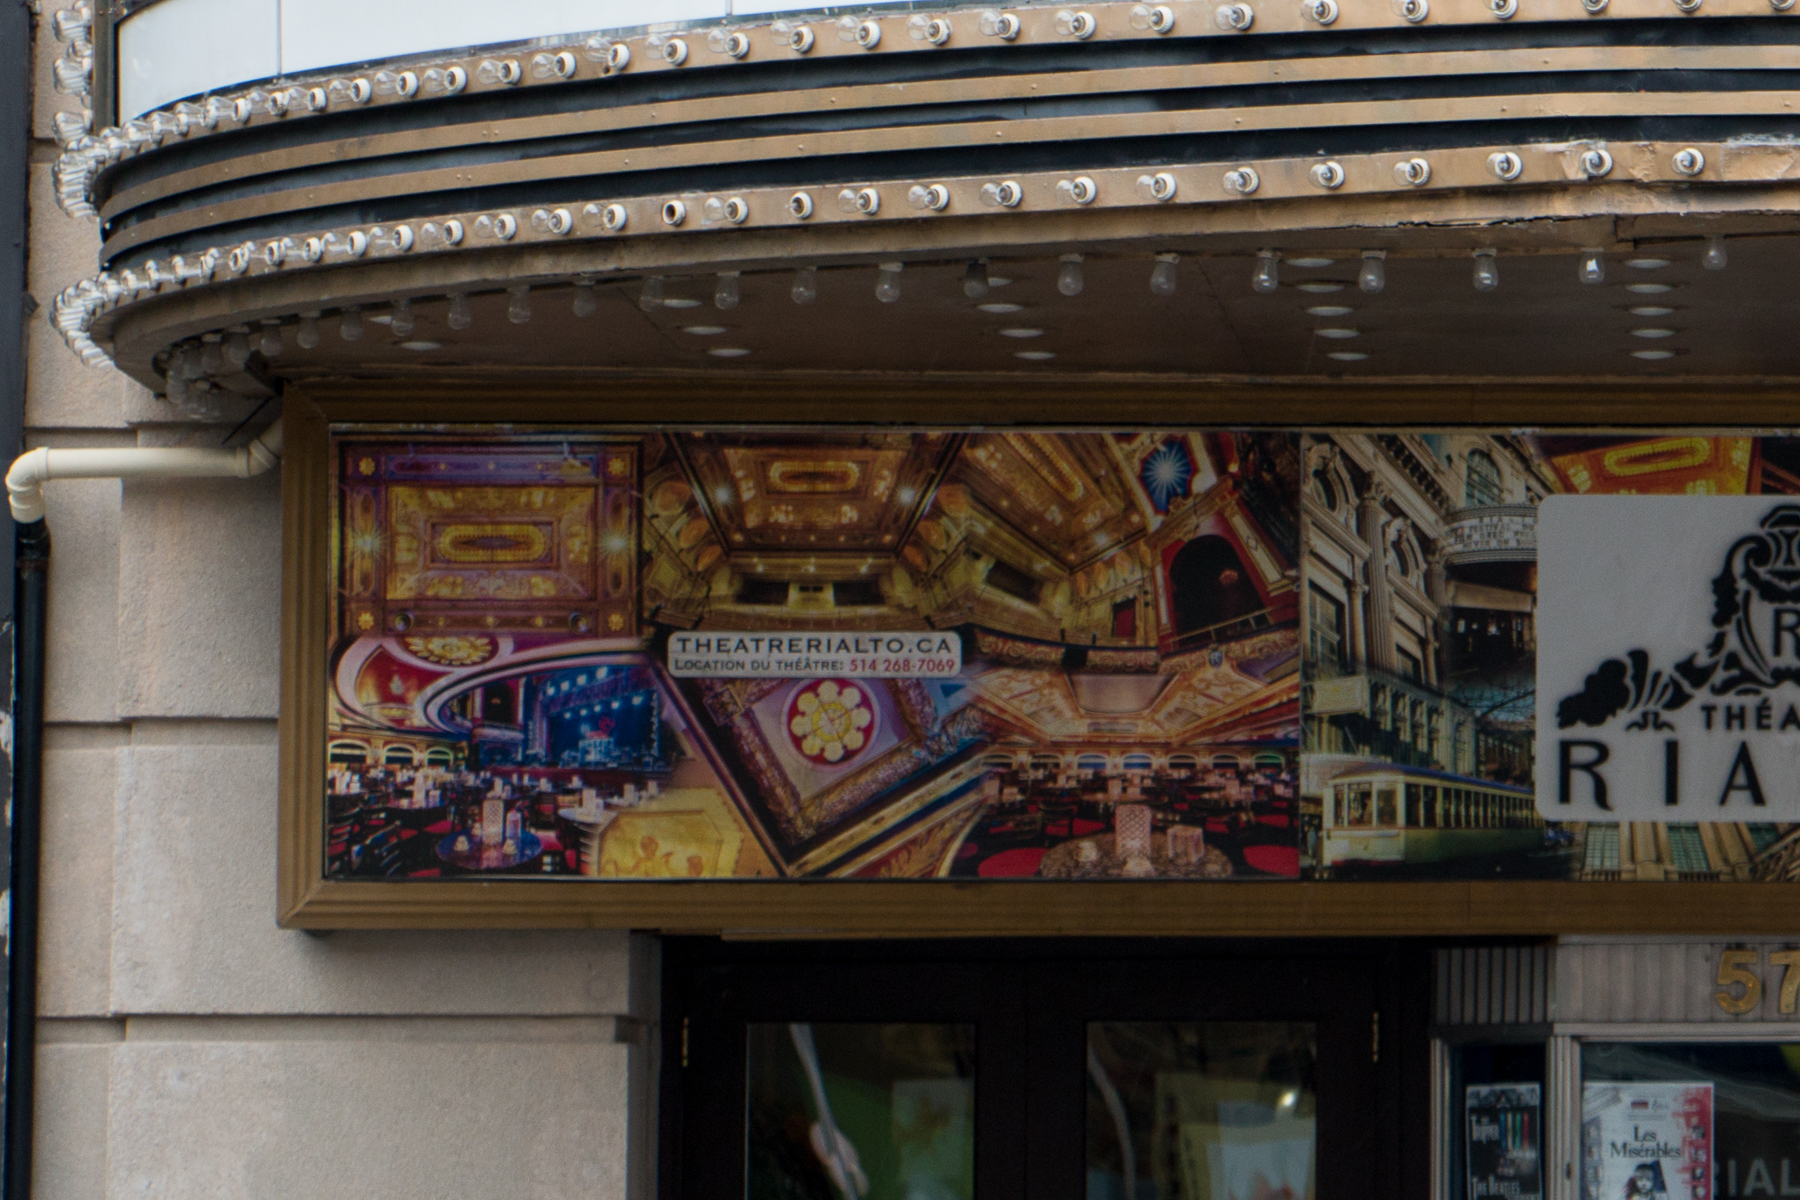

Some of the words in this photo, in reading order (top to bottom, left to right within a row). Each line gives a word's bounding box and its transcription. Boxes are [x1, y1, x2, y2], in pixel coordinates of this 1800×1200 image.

[676, 637, 952, 654] THEATRERIALTO.CA
[849, 658, 878, 672] 514
[883, 658, 956, 672] 268-7069
[1634, 1125, 1657, 1141] Les
[1610, 1142, 1682, 1158] Misérables
